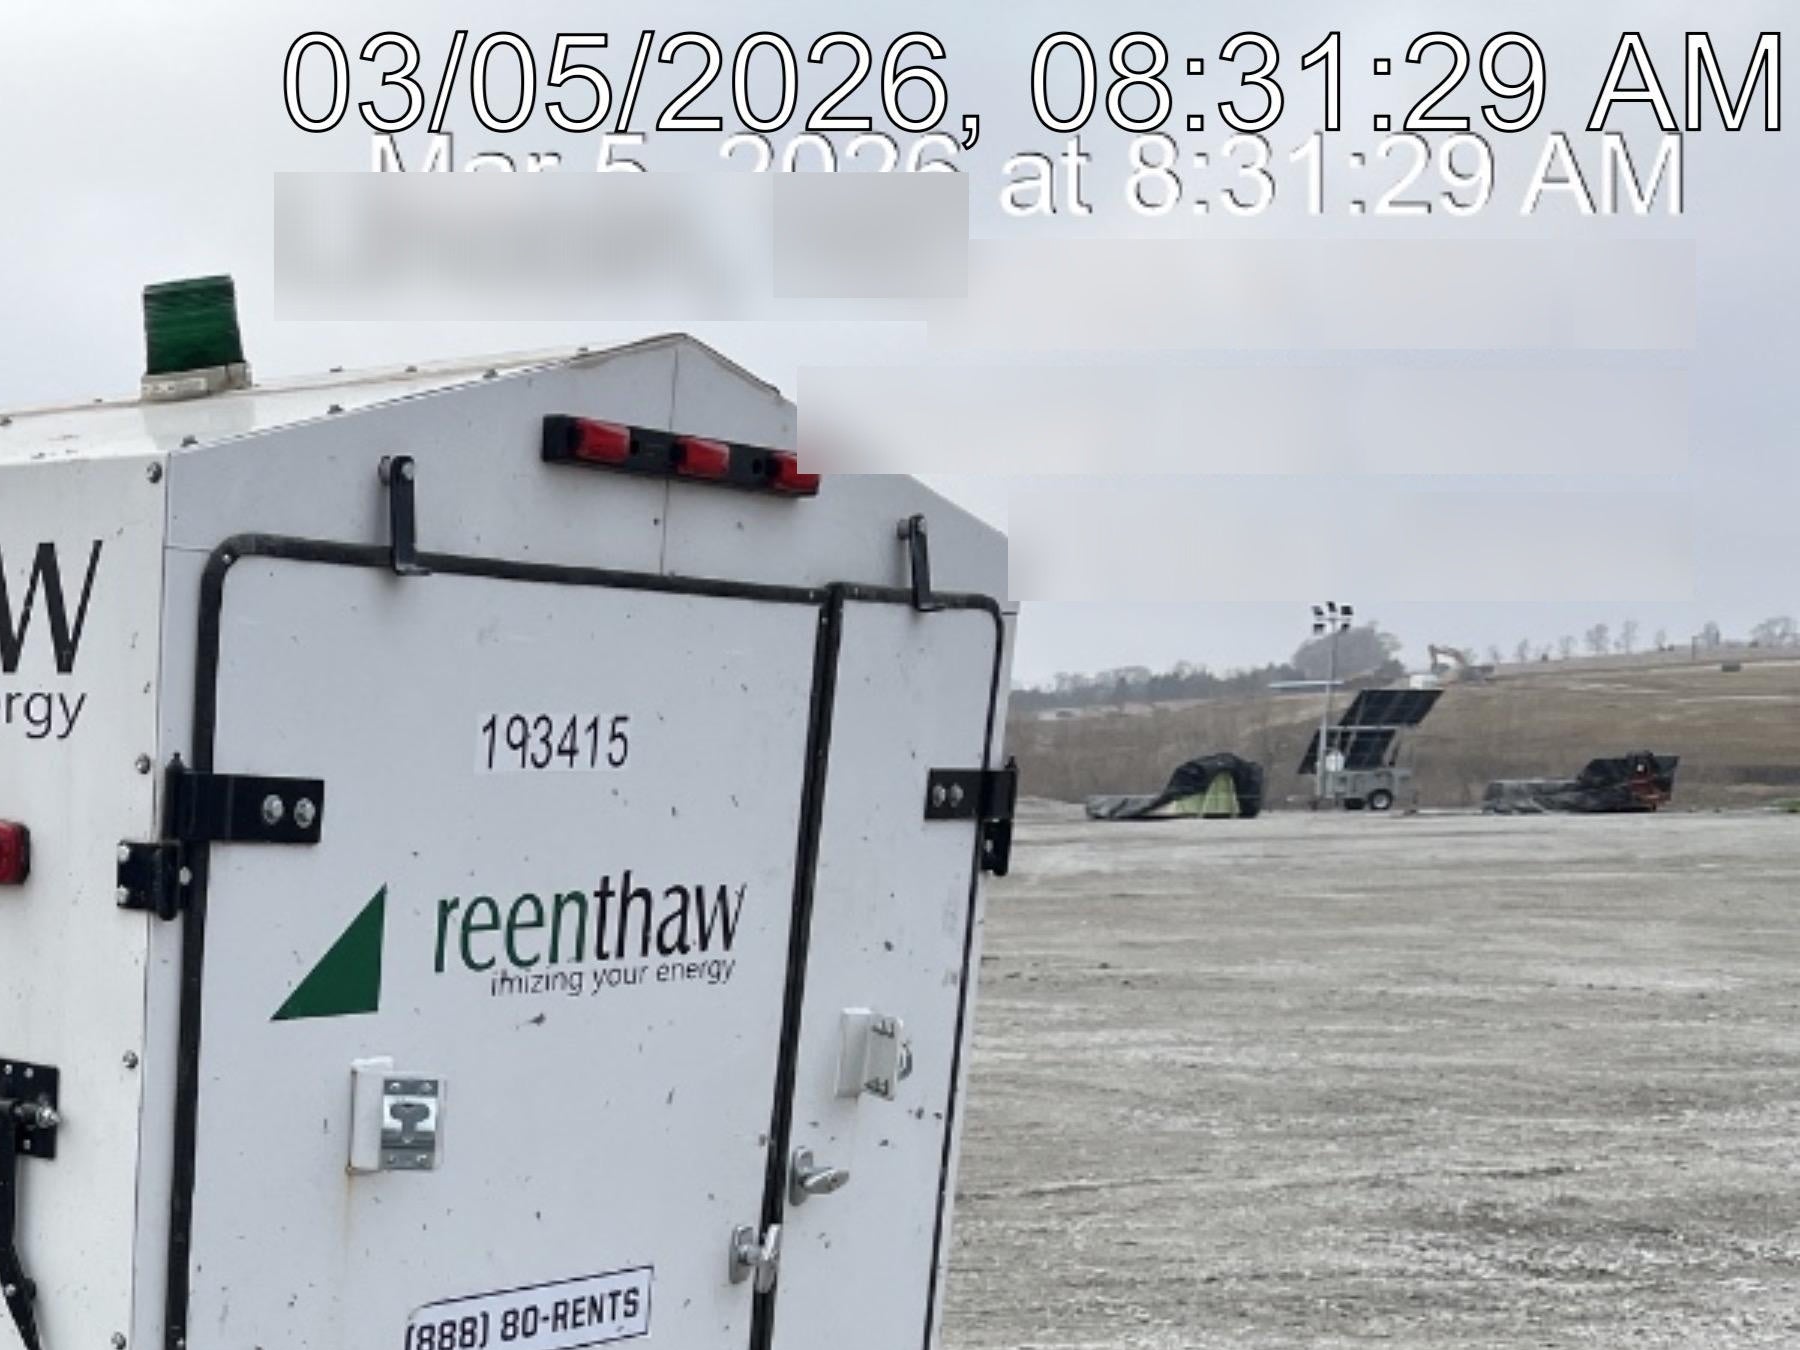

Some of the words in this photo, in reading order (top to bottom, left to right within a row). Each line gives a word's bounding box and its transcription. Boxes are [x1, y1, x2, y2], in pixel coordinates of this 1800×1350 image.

[481, 713, 630, 770] 193415
[591, 964, 649, 996] your
[656, 957, 736, 985] energy
[500, 1286, 640, 1342] 80-RENTS
